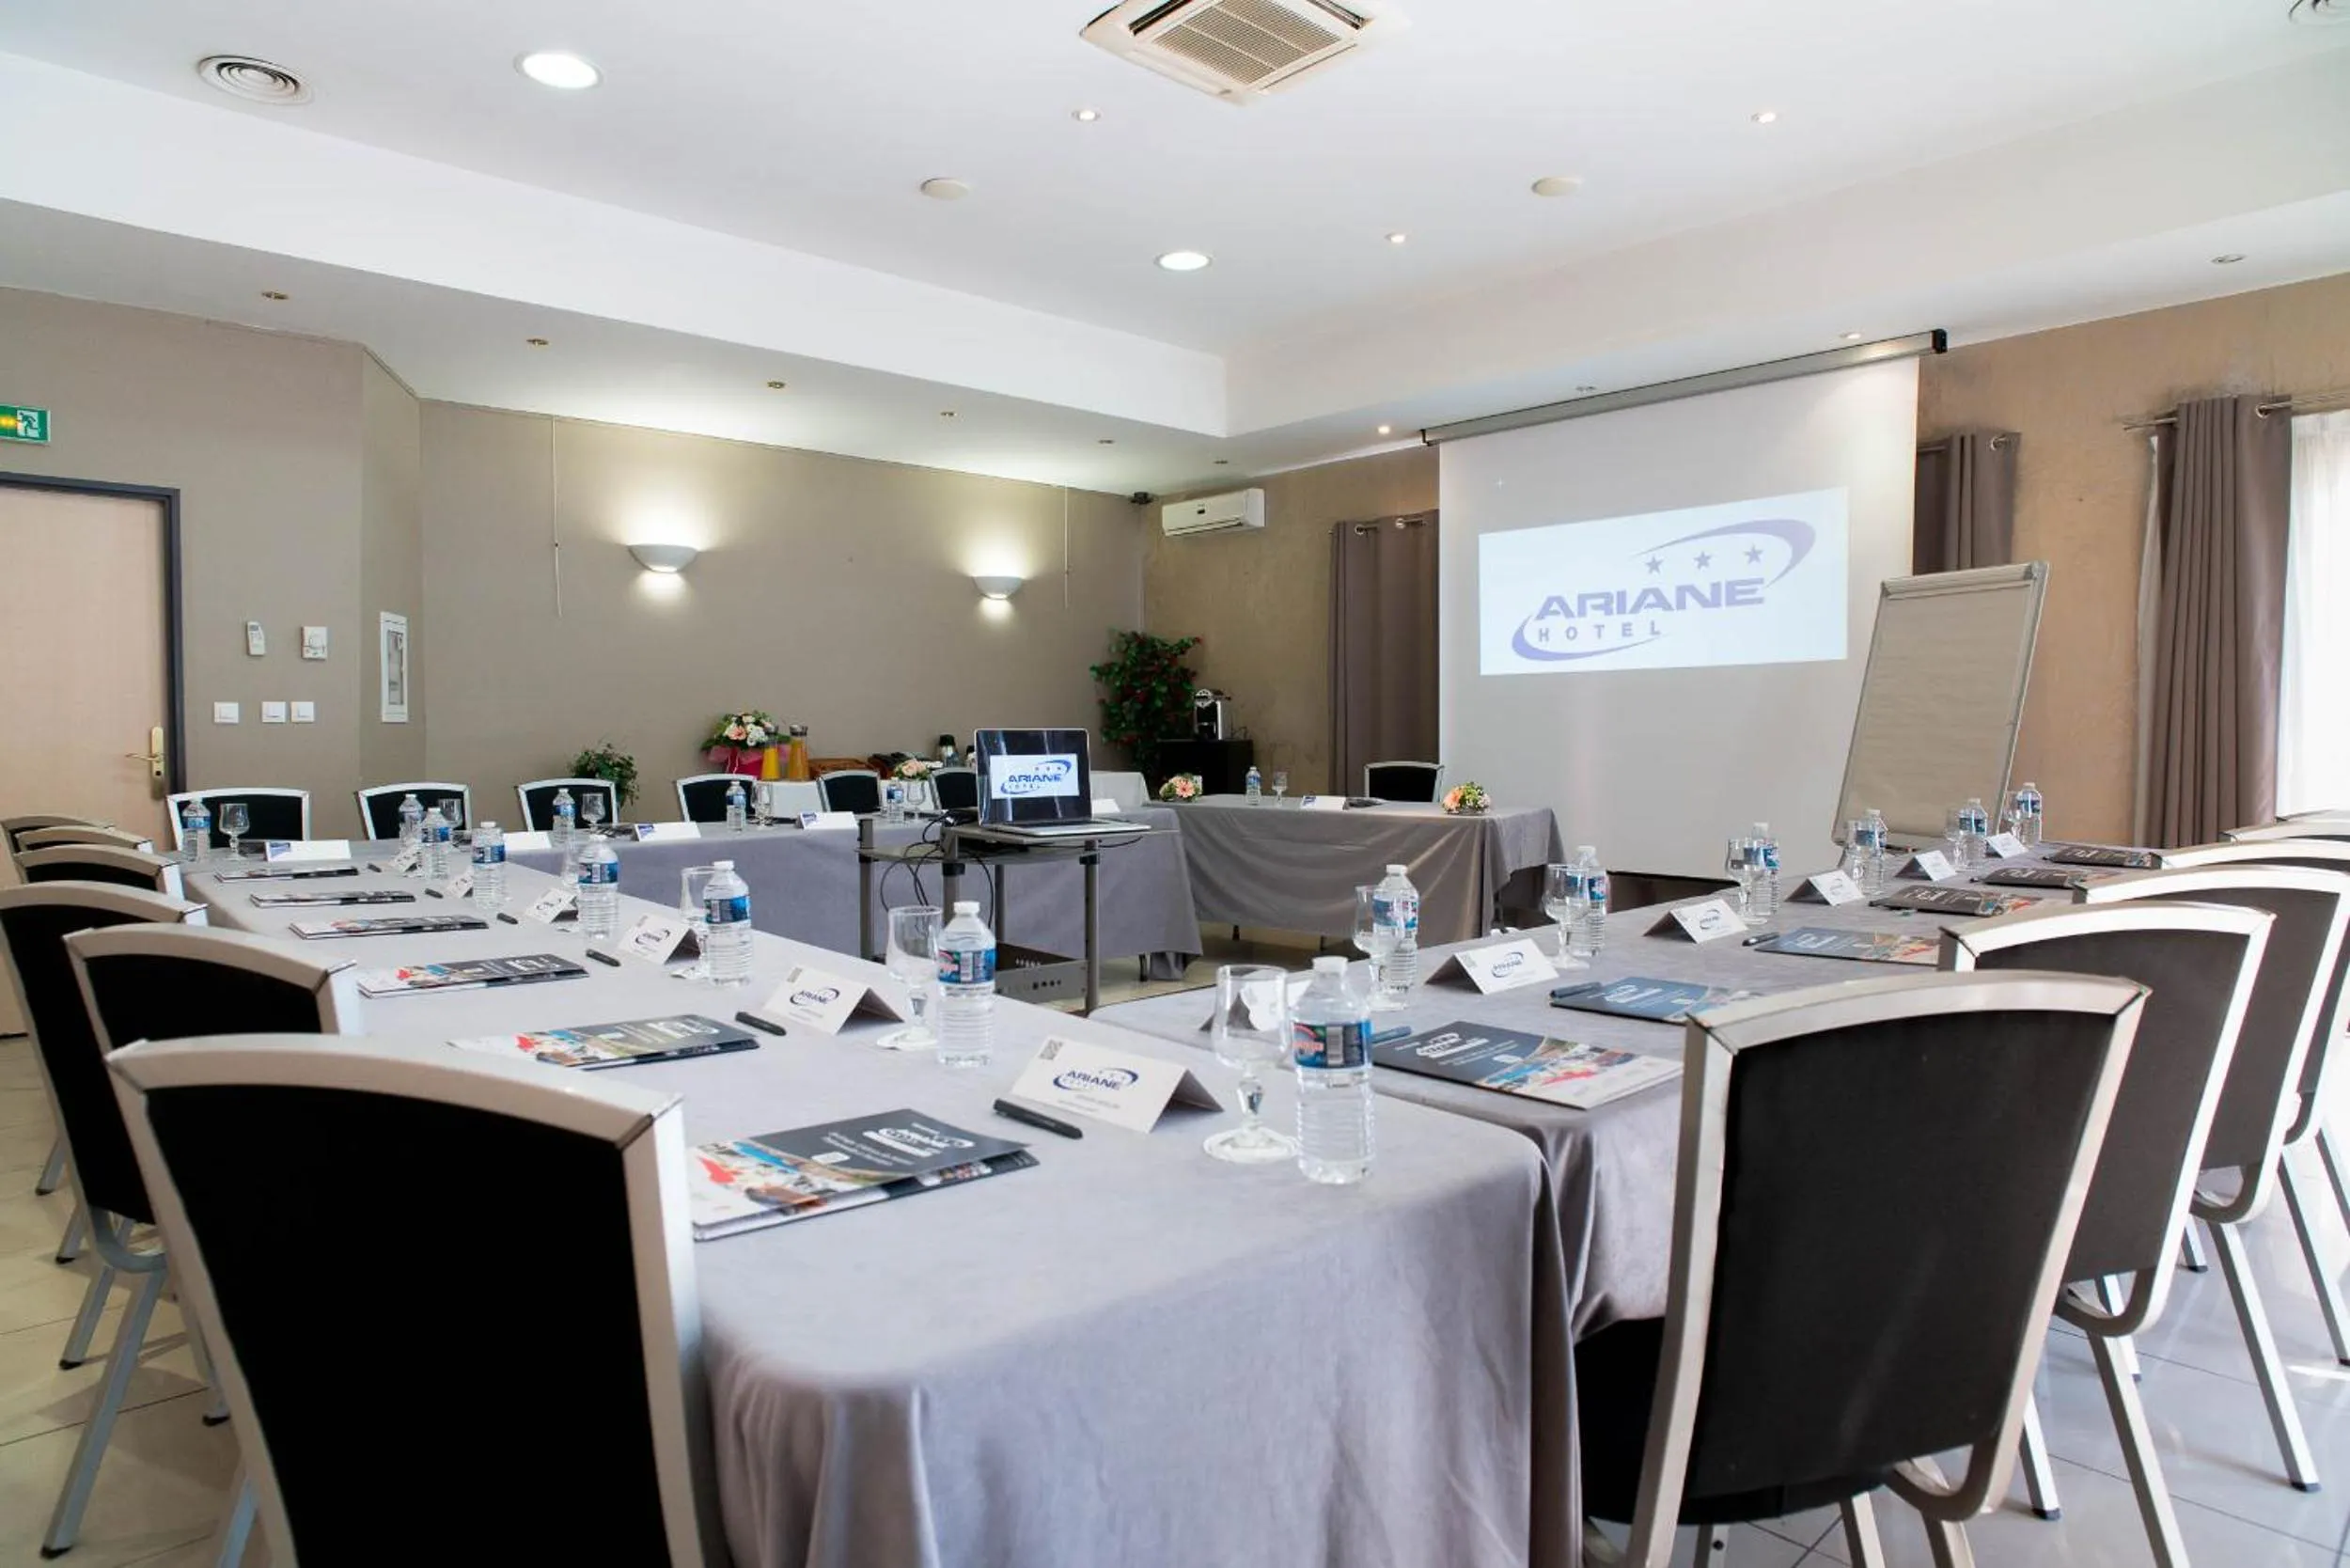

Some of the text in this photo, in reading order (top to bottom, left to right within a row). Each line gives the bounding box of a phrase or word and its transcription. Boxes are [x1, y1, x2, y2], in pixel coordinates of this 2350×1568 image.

[1534, 577, 1765, 621] ARIANE
[1538, 619, 1663, 643] HOTEL
[1008, 773, 1062, 784] ARIANE
[1066, 1070, 1122, 1091] ARIANE
